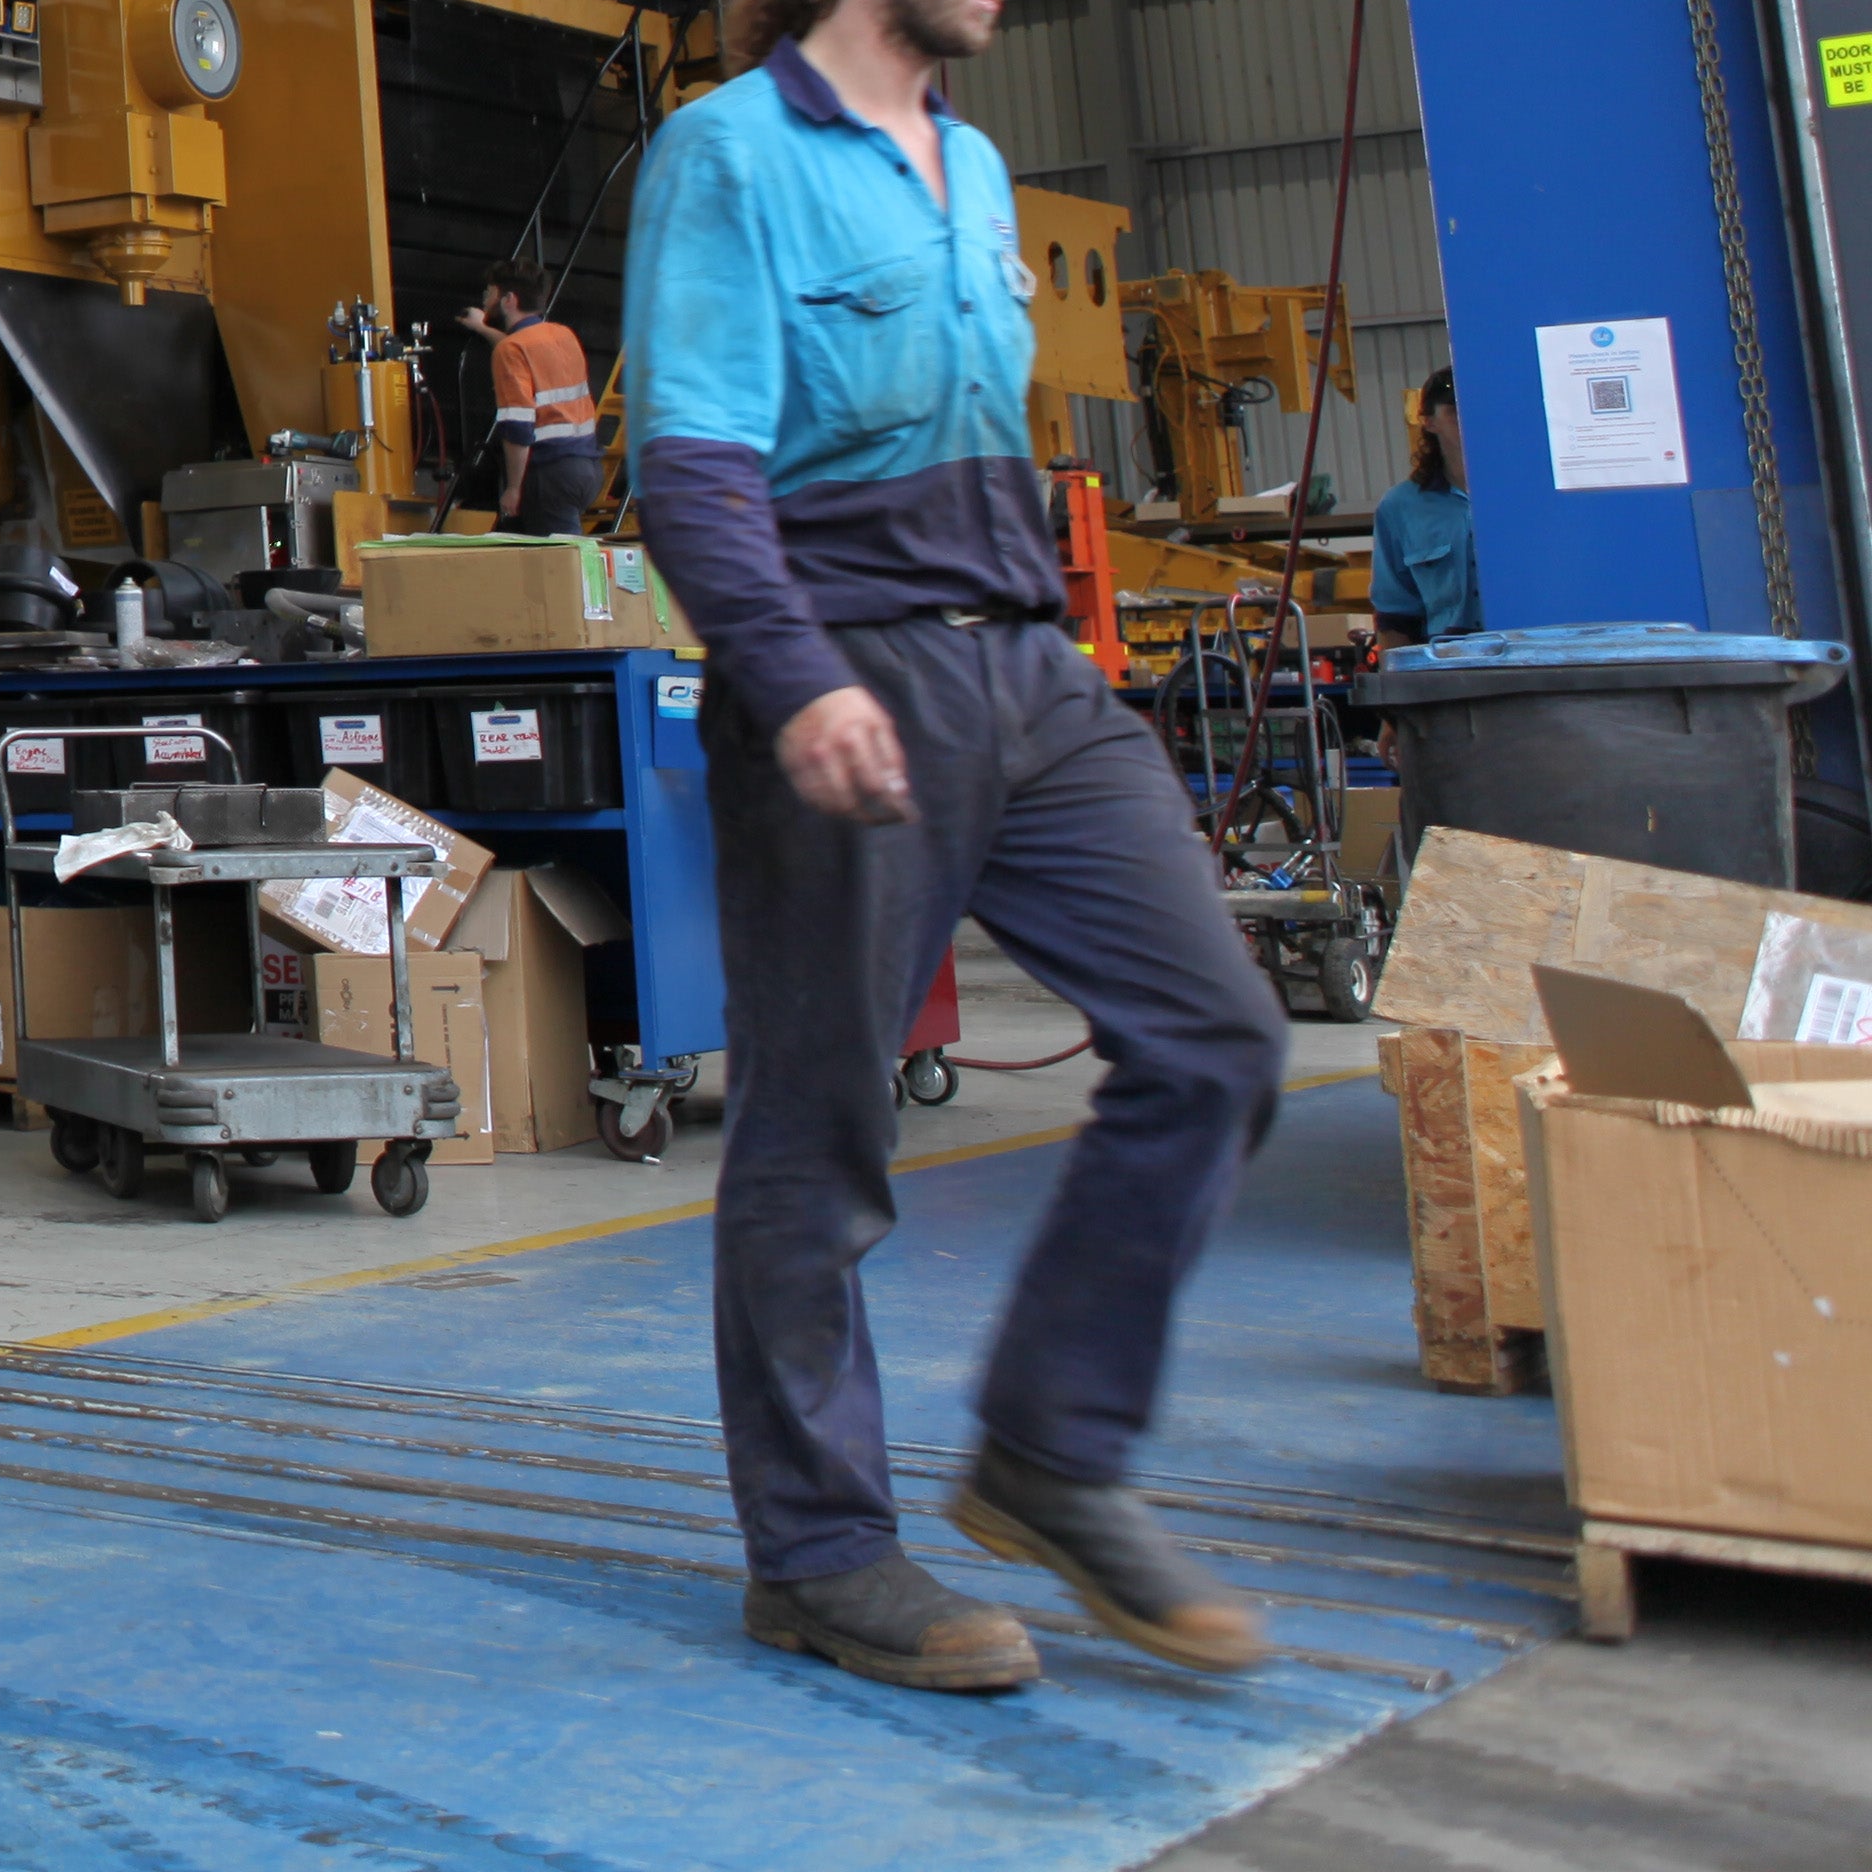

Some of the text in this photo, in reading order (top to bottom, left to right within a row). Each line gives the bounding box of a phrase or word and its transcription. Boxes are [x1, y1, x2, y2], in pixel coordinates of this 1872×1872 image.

[1829, 61, 1872, 78] MUST
[1843, 79, 1865, 94] BE
[479, 732, 509, 743] REAR
[263, 953, 305, 985] SE
